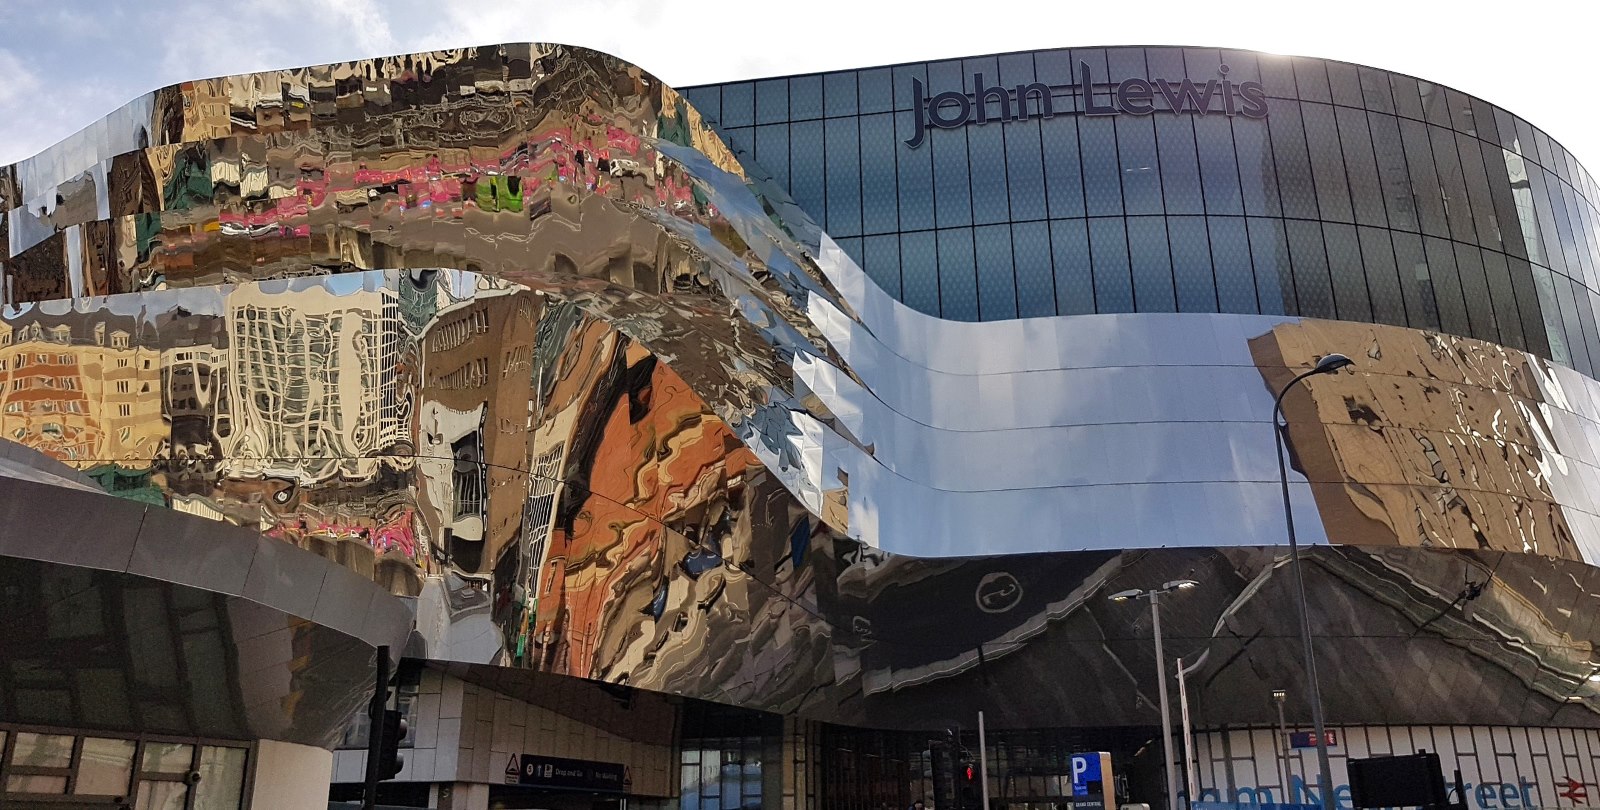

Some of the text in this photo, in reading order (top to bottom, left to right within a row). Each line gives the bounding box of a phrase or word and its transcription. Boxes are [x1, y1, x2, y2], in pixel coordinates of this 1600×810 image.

[904, 59, 1270, 149] John Lewis
[1072, 757, 1087, 783] P
